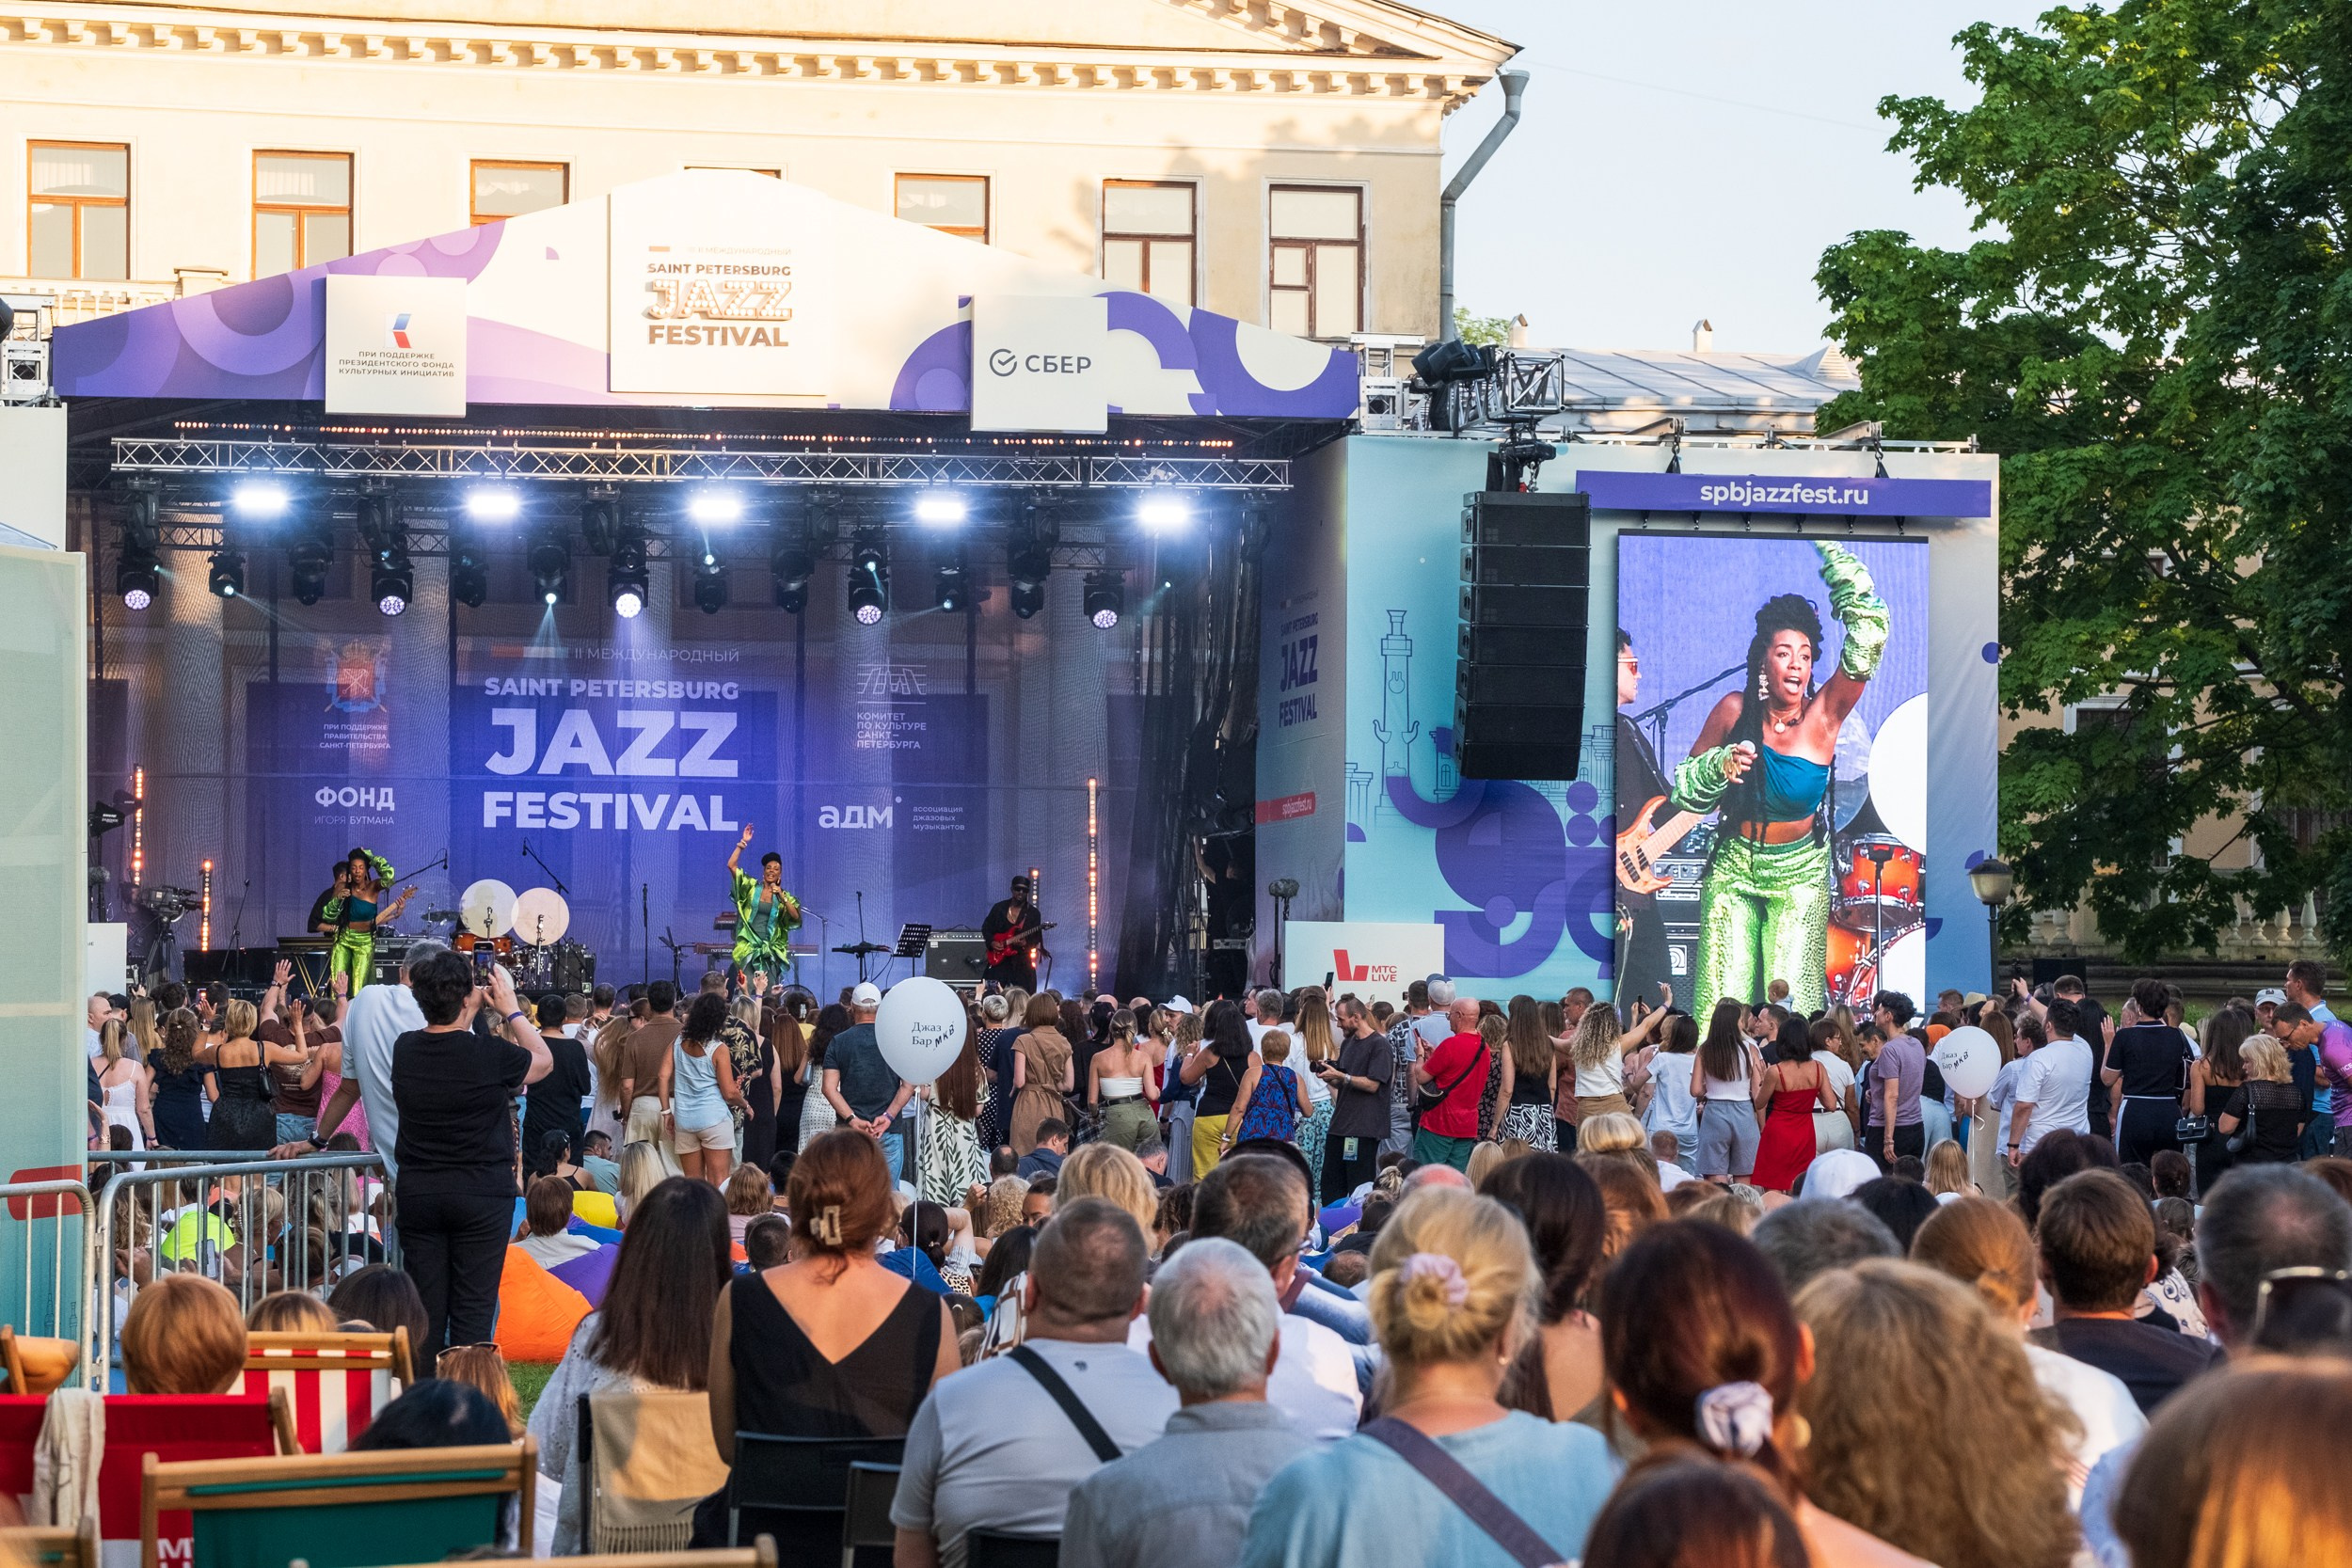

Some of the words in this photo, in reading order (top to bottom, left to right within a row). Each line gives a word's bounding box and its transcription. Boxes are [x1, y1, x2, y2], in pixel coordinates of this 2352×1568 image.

[647, 263, 691, 274] SAINT
[695, 264, 791, 277] PETERSBURG
[646, 278, 792, 322] JAZZ
[648, 325, 789, 347] FESTIVAL
[339, 359, 419, 368] ПРЕЗИДЕНТСКОГО
[1025, 355, 1091, 373] СБЕР
[1700, 481, 1868, 507] spbjazzfest.ru
[587, 647, 739, 663] МЕЖДУНАРОДНЫЙ
[1280, 634, 1318, 692] JAZZ
[485, 677, 563, 696] SAINT
[570, 678, 739, 700] PETERSBURG
[857, 712, 906, 721] КОМИТЕТ
[1279, 693, 1317, 728] FESTIVAL
[857, 721, 872, 730] ПО
[875, 721, 927, 731] КУЛЬТУРЕ
[319, 741, 391, 750] САНКТ-ПЕТЕРБУРГА
[485, 707, 739, 778] JAZZ
[857, 740, 921, 749] ПЕТЕРБУРГА
[314, 785, 395, 812] ФОНД
[483, 791, 739, 832] FESTIVAL
[314, 816, 346, 825] ИГОРЯ
[349, 816, 394, 825] БУТМАНА
[913, 823, 965, 832] музыкантов
[1371, 974, 1397, 982] LIVE
[912, 1022, 942, 1034] Джаз
[912, 1036, 932, 1048] Бар
